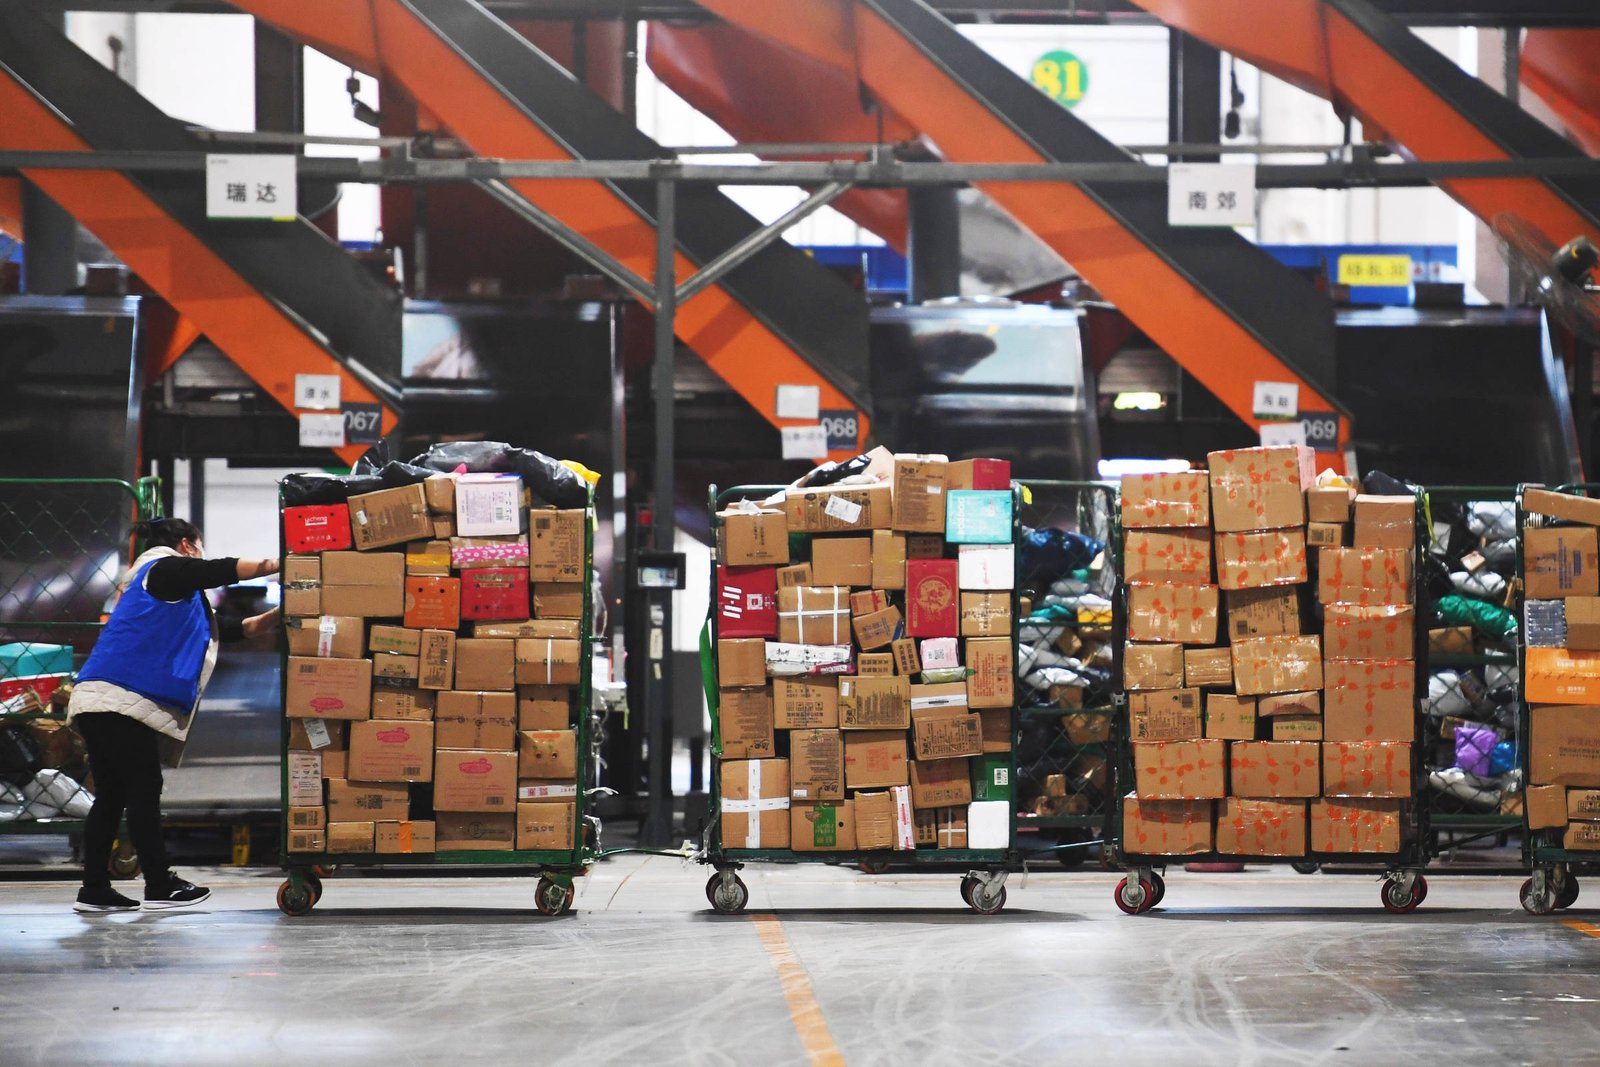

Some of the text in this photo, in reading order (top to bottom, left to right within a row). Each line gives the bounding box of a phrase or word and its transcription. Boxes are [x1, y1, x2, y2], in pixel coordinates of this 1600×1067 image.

[1034, 60, 1082, 99] 81
[227, 182, 277, 203] 瑞达
[1188, 191, 1236, 210] 南郊
[343, 411, 379, 431] 067
[821, 417, 857, 437] 068
[1302, 419, 1337, 439] 069
